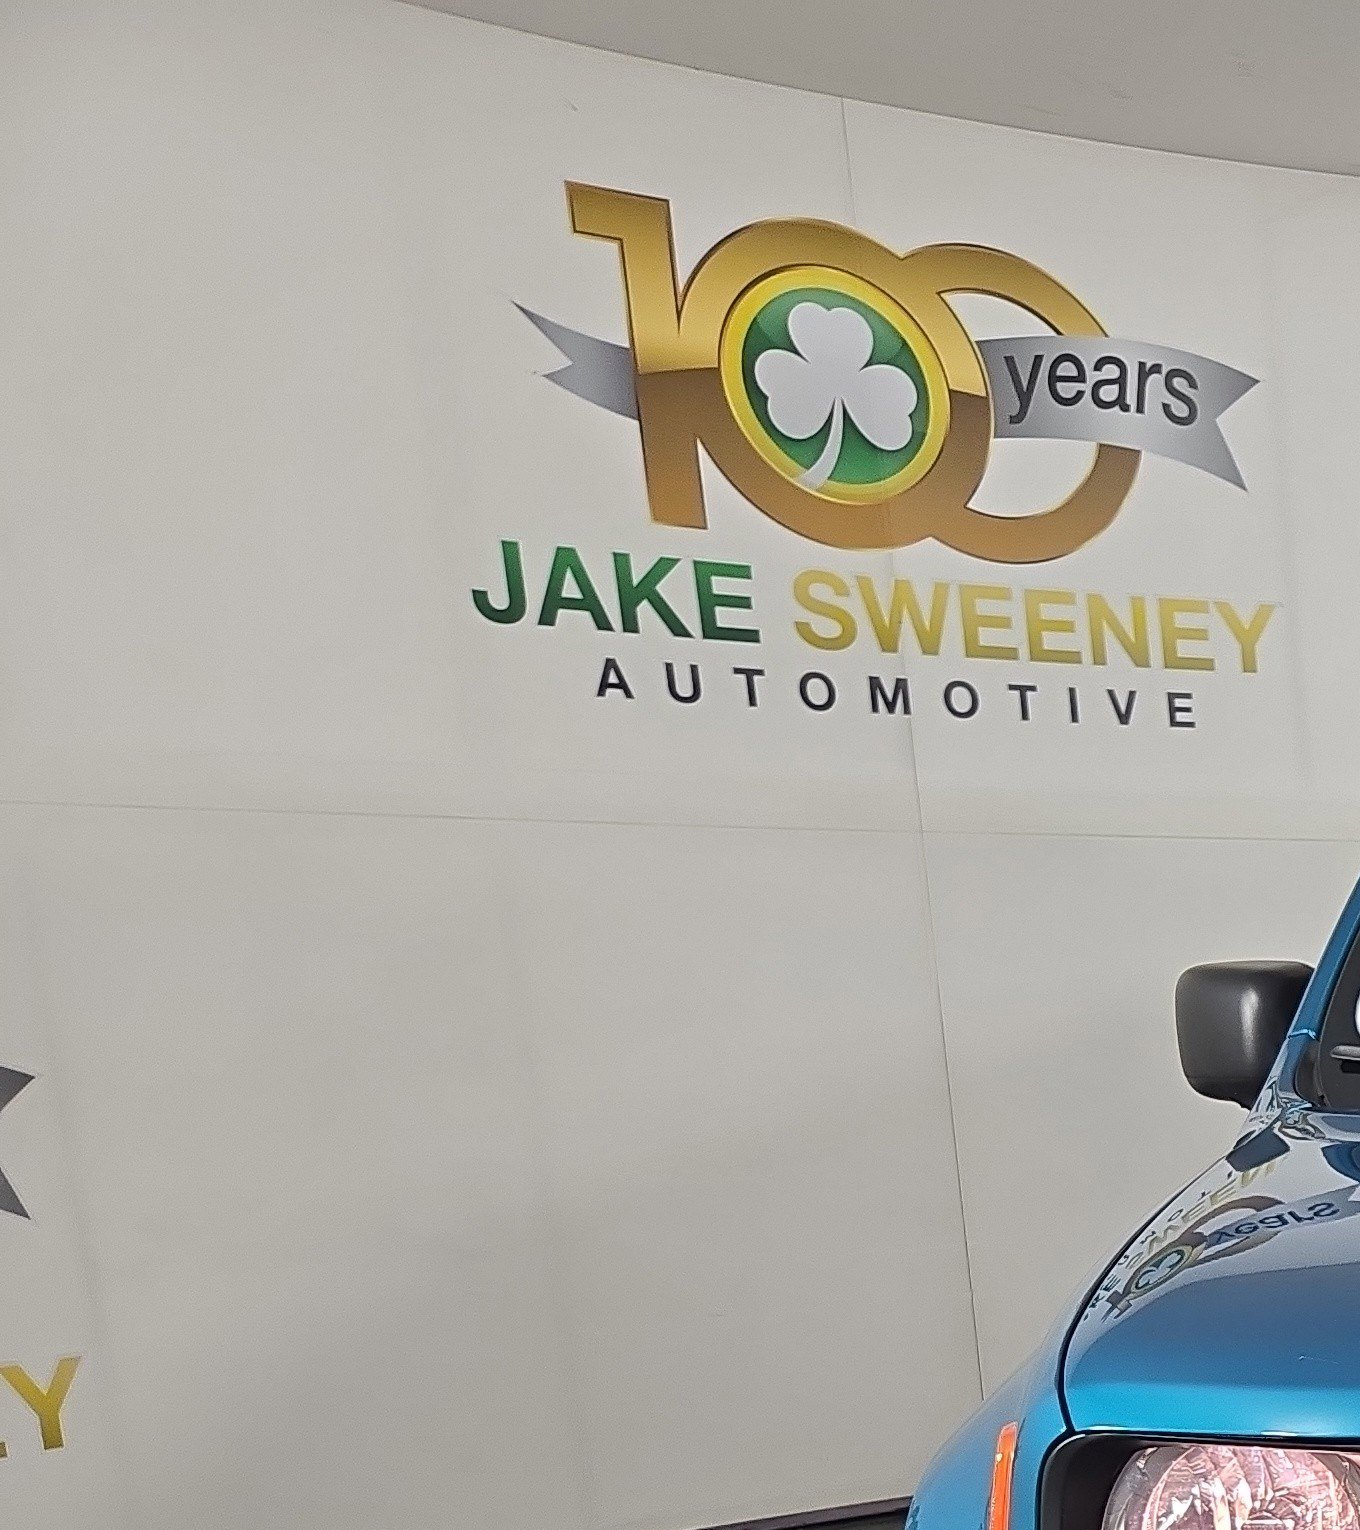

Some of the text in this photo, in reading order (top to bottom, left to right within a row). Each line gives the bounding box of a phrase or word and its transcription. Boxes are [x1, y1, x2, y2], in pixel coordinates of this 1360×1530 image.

[1003, 352, 1200, 427] years
[472, 540, 1276, 675] JAKE SWEENEY
[597, 658, 1197, 728] AUTOMOTIVE
